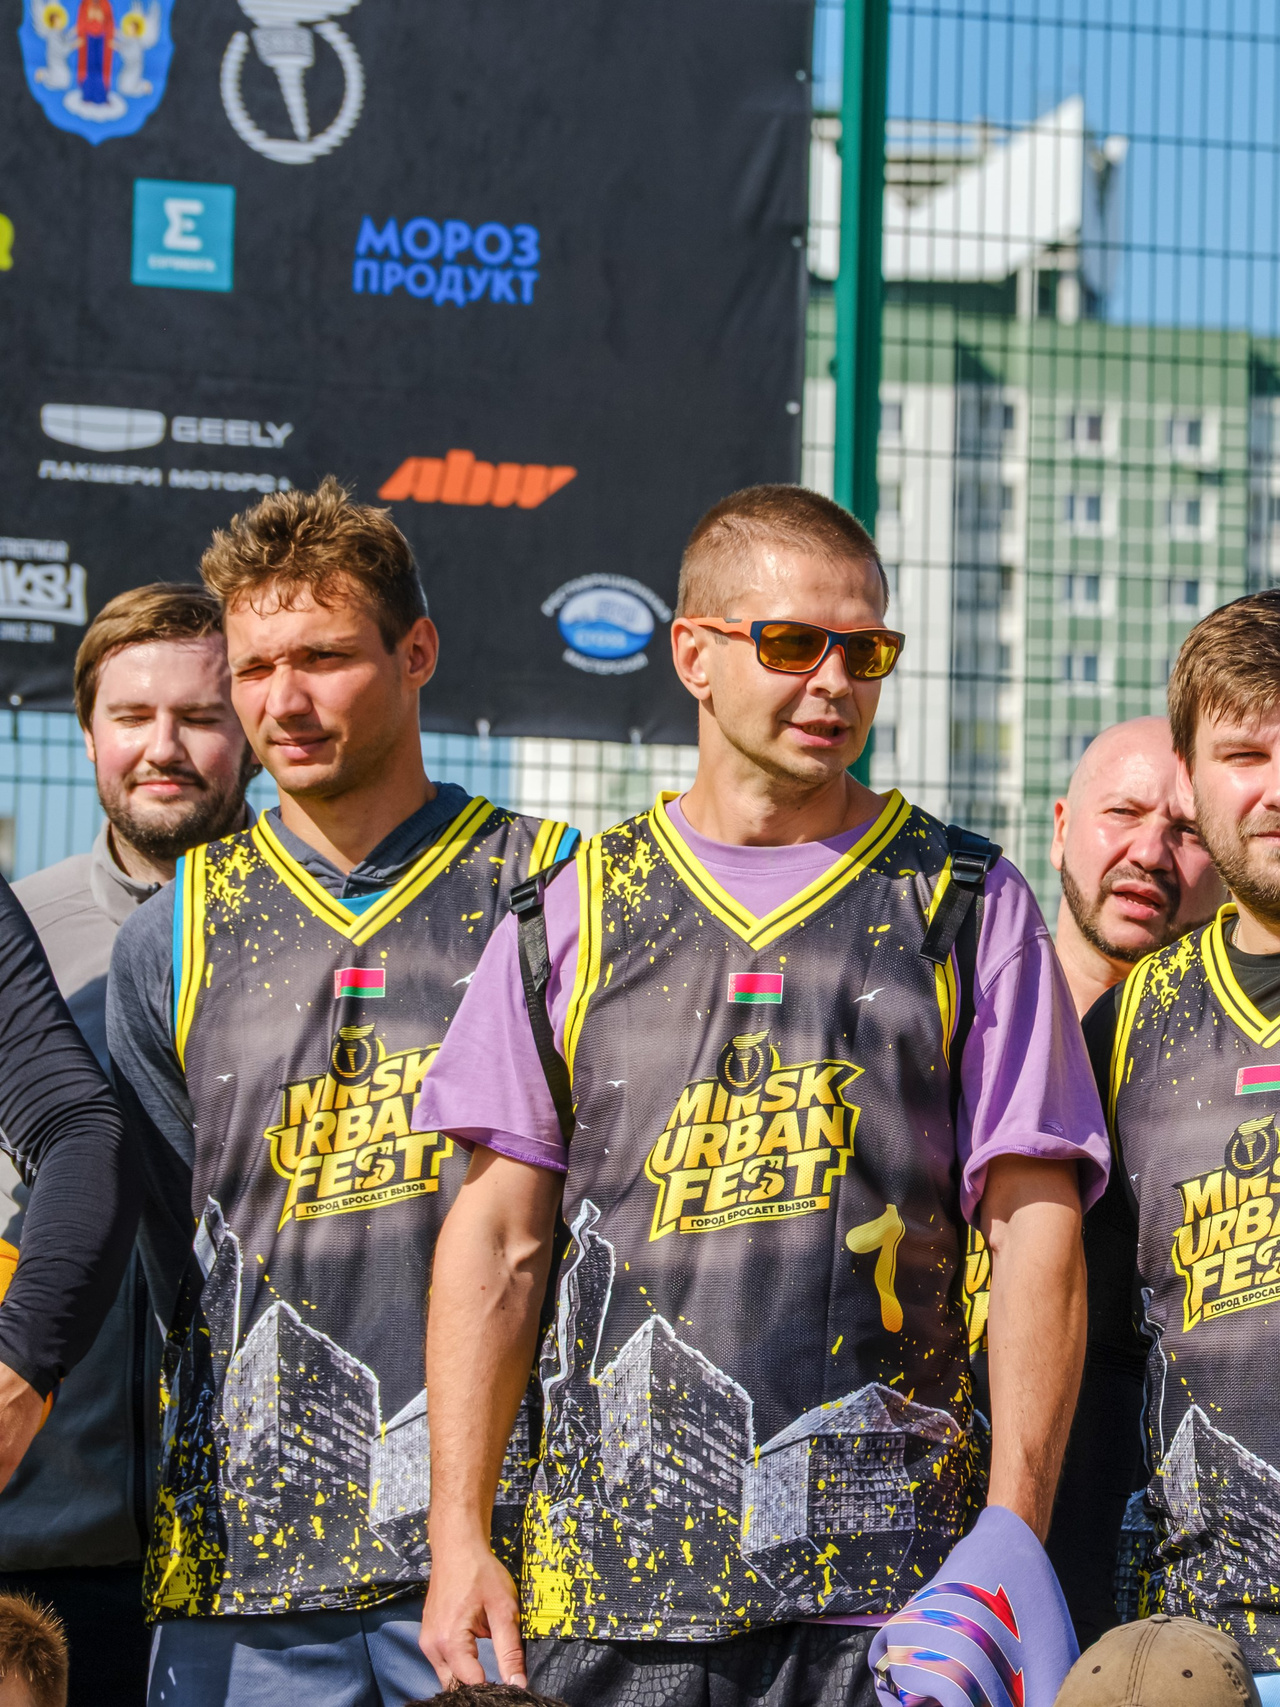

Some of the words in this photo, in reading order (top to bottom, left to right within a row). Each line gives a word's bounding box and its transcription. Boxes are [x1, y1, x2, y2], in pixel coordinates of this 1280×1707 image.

[355, 214, 541, 269] МОРОЗ
[352, 258, 541, 308] ПРОДУКТ
[171, 415, 295, 449] GEELY
[168, 467, 277, 493] МОТОРС
[289, 1049, 439, 1126] MINSK
[665, 1066, 845, 1131] MINSK
[277, 1092, 424, 1170] URBA
[651, 1106, 845, 1174] URBAN
[282, 1131, 439, 1214] FEST
[305, 1200, 341, 1215] ГОРОД
[342, 1189, 389, 1206] БРОСАЕТ
[390, 1181, 427, 1197] ВЫЗОВ
[660, 1147, 832, 1228] FEST
[690, 1215, 726, 1229] ГОРОД
[727, 1204, 775, 1221] БРОСАЕТ
[777, 1198, 817, 1214] ВЫЗОВ
[846, 1203, 906, 1333] 1
[1209, 1296, 1241, 1314] ГОРОД
